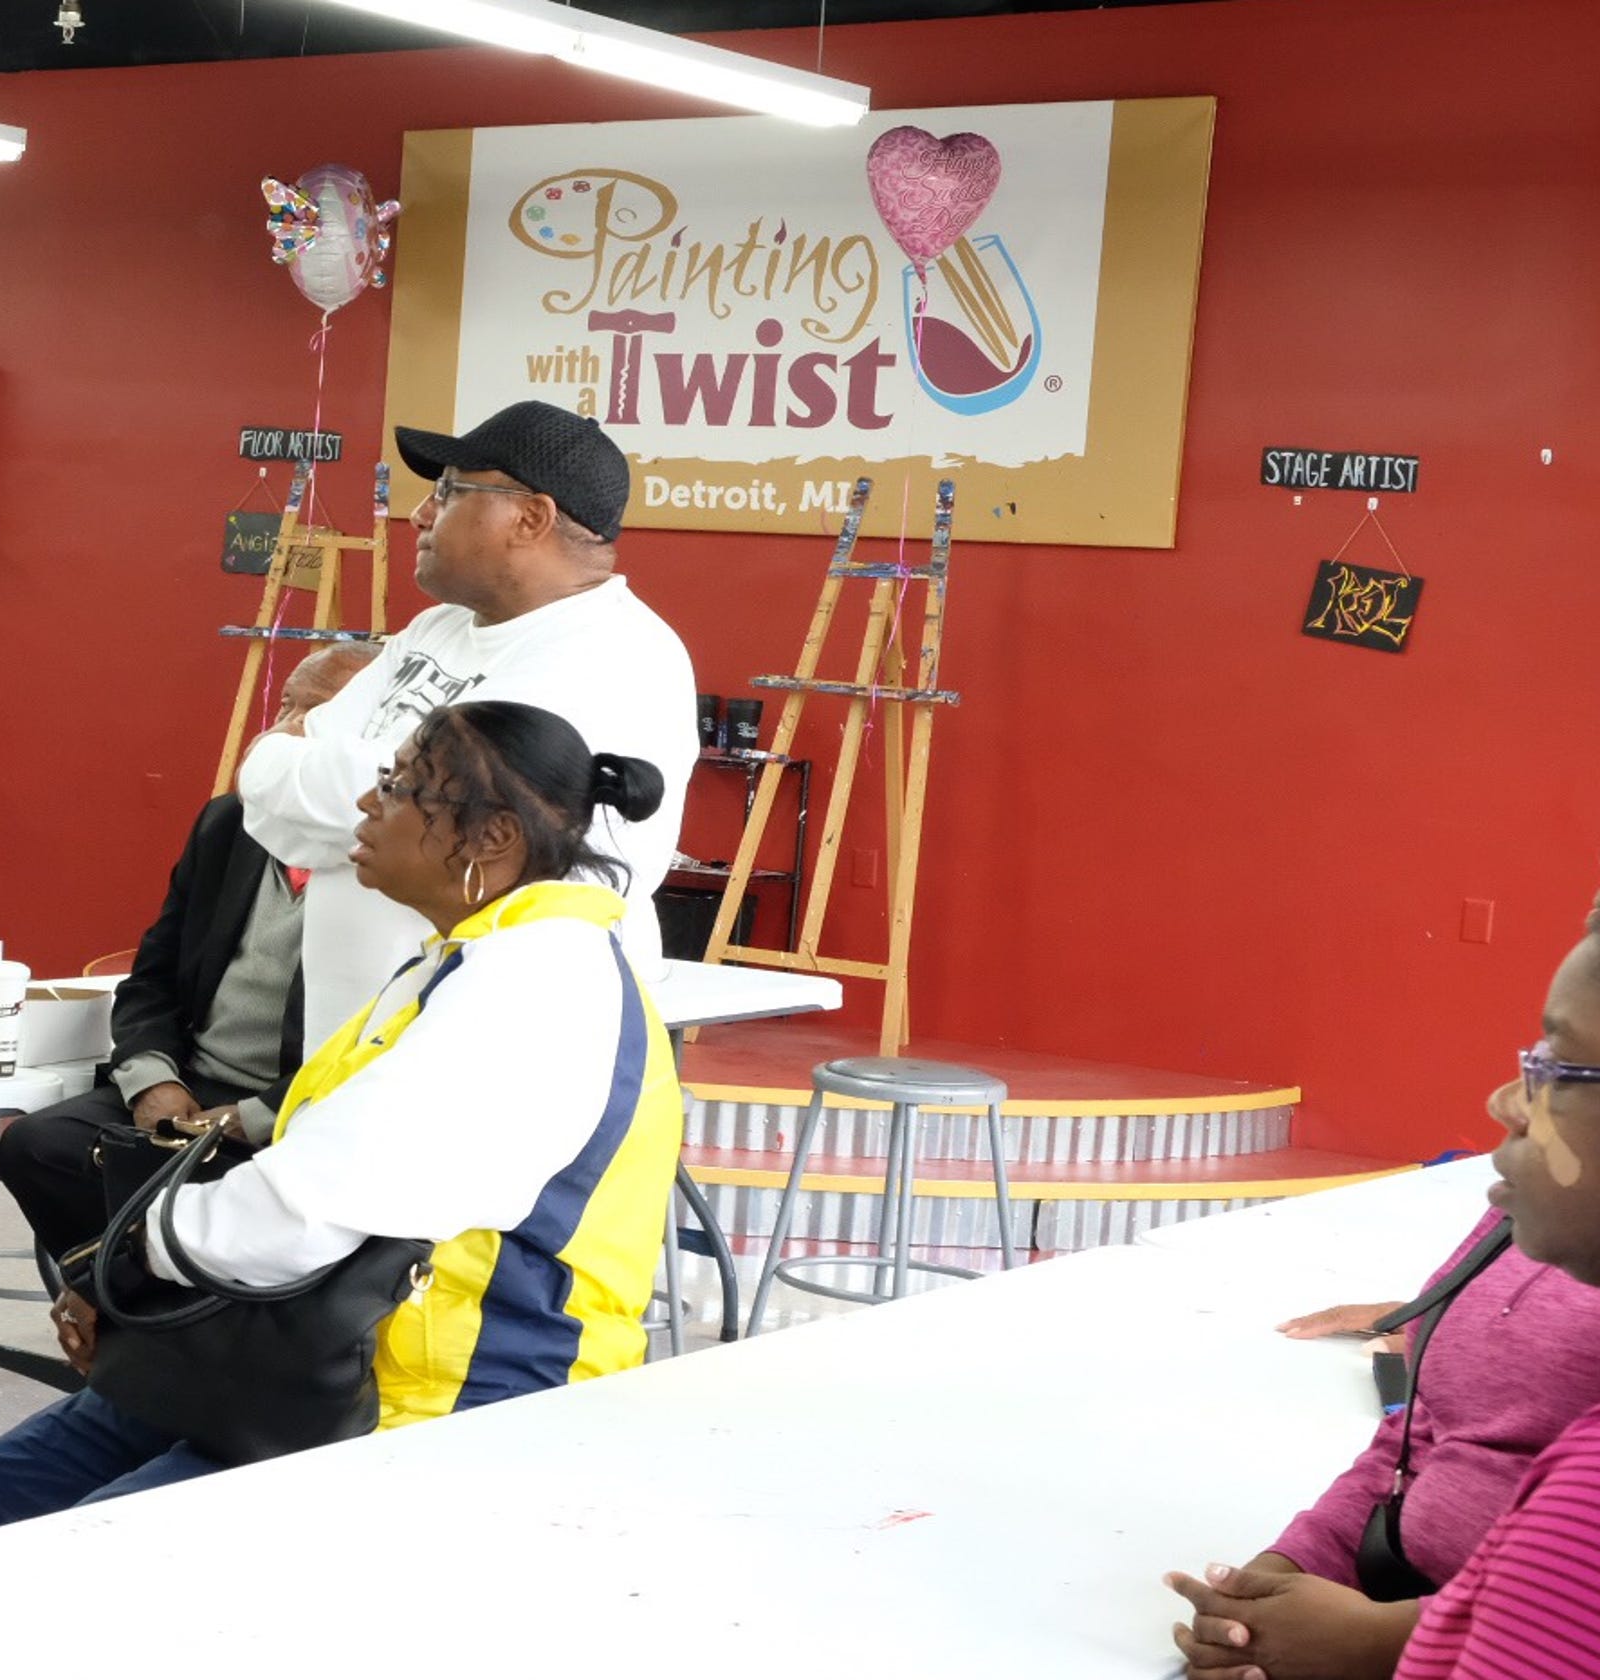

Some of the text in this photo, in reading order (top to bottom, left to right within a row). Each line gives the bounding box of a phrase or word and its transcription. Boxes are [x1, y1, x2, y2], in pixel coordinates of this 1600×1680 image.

[509, 168, 879, 343] Painting
[526, 346, 600, 384] with
[587, 309, 897, 430] Twist
[577, 387, 597, 417] a
[239, 430, 342, 460] FLOOR ARTIST
[1264, 450, 1419, 493] STAGE ARTIST
[644, 476, 852, 514] Detroit, MI
